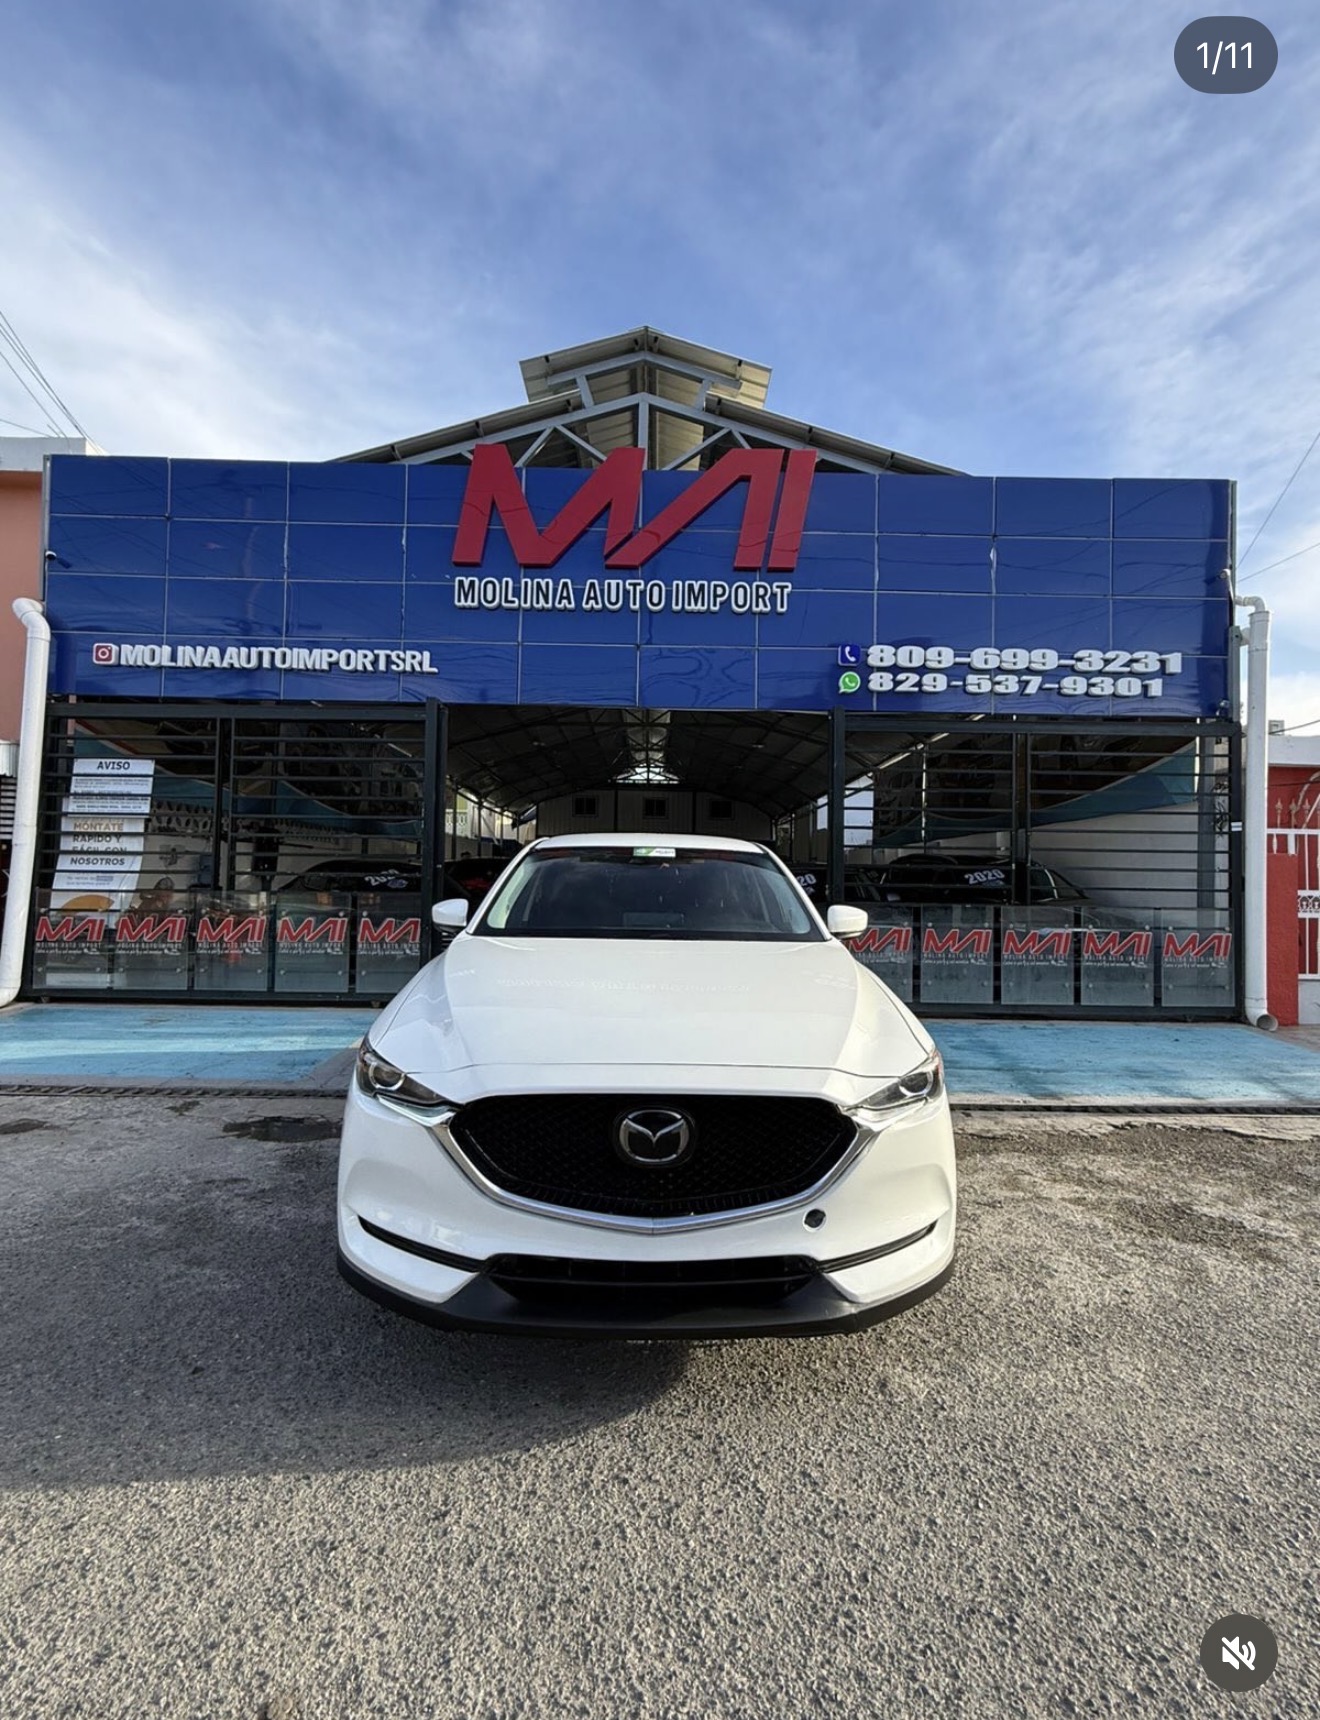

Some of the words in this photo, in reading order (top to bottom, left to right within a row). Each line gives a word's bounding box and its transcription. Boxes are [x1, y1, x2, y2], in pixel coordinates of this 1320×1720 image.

[452, 444, 817, 571] MAI
[454, 576, 575, 610] MOLINA
[582, 579, 664, 611] AUTO
[671, 580, 792, 613] IMPORT
[120, 644, 438, 673] MOLINAAUTOIMPORTSRL
[867, 645, 1183, 674] 809-699-3231
[868, 672, 1163, 698] 829-537-9301
[97, 761, 131, 770] AVISO
[70, 857, 125, 866] NOSOTROS
[964, 869, 1005, 885] 2020
[35, 916, 106, 942] MAI
[116, 917, 187, 942] MAI
[196, 917, 267, 942] MAI
[277, 917, 348, 943] MAI
[357, 918, 421, 943] MA
[923, 928, 992, 953] MAI
[1002, 930, 1072, 955] MAI
[1083, 931, 1153, 956] MAI
[1163, 932, 1232, 957] MAI
